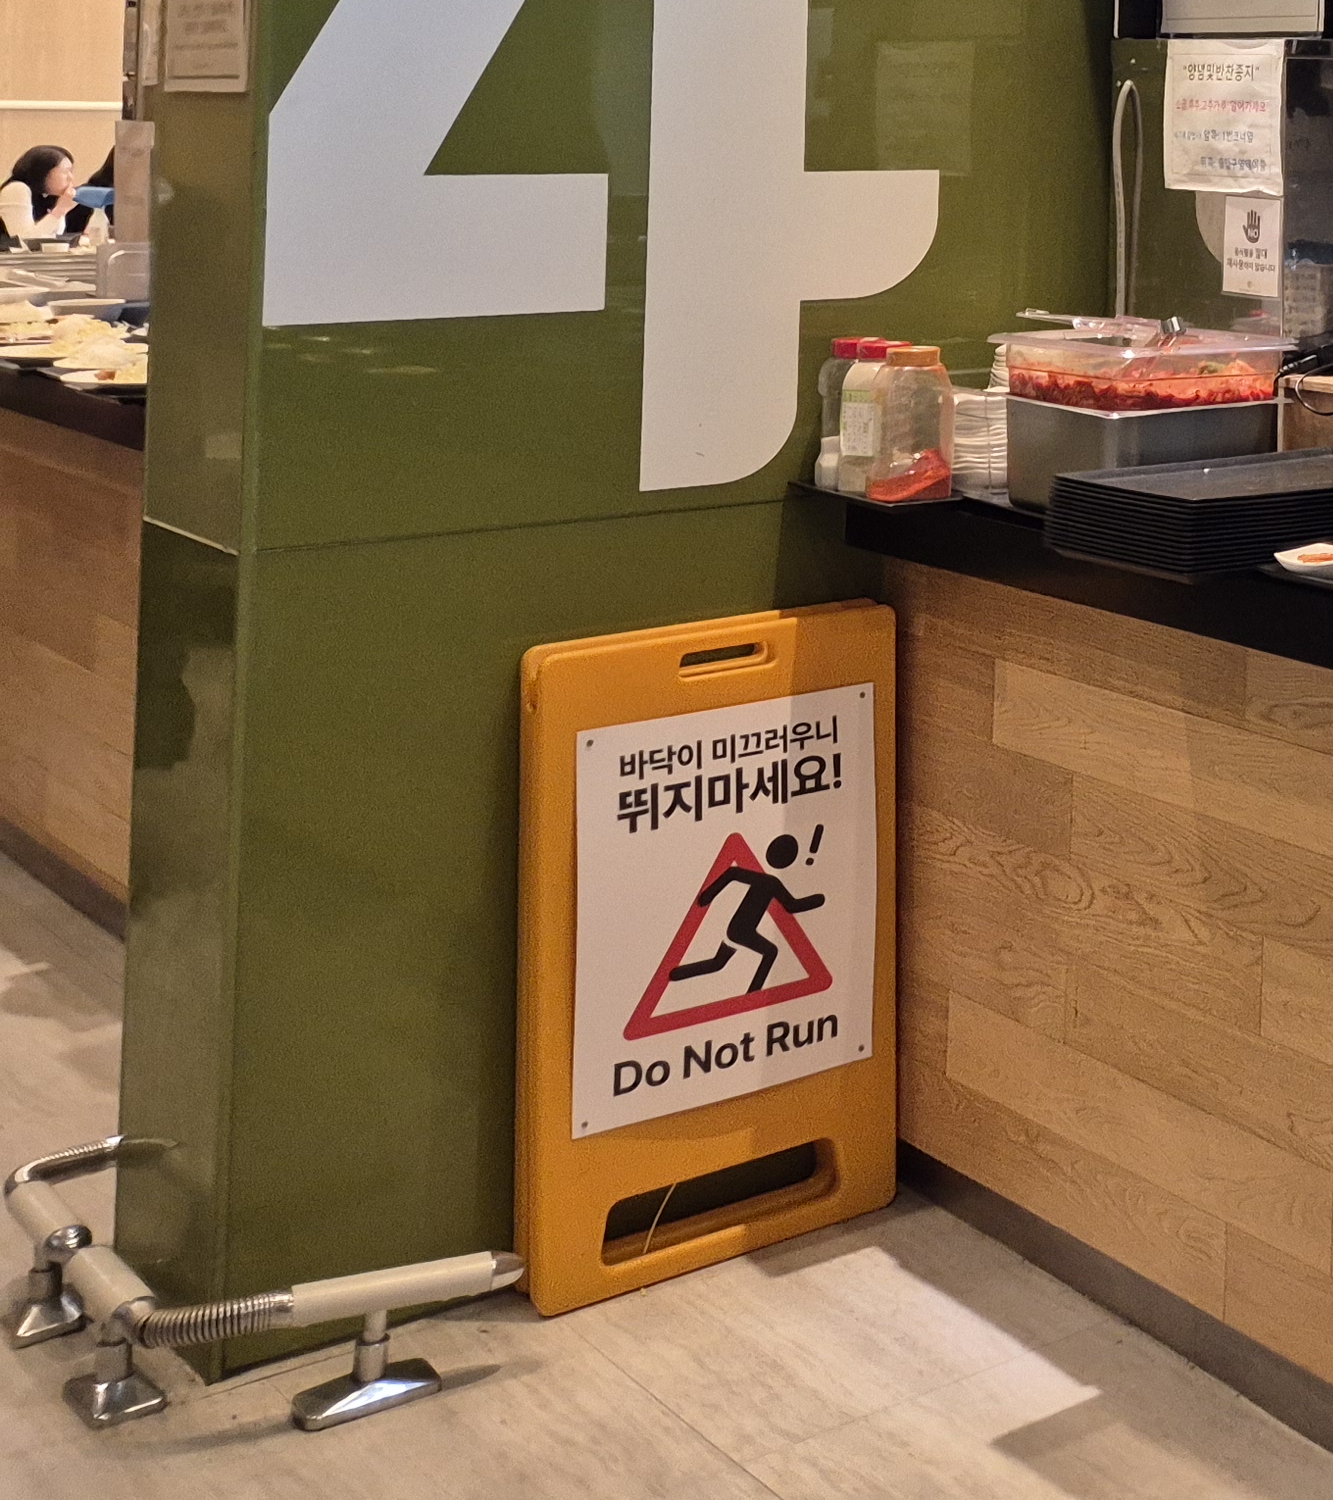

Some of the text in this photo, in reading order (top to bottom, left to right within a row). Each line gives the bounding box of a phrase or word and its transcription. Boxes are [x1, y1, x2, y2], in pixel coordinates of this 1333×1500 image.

[1247, 227, 1259, 239] NO
[619, 715, 838, 780] 바닥이 미끄러우니
[617, 753, 843, 834] 뛰지마세요!
[613, 1014, 838, 1097] Do Not Run
